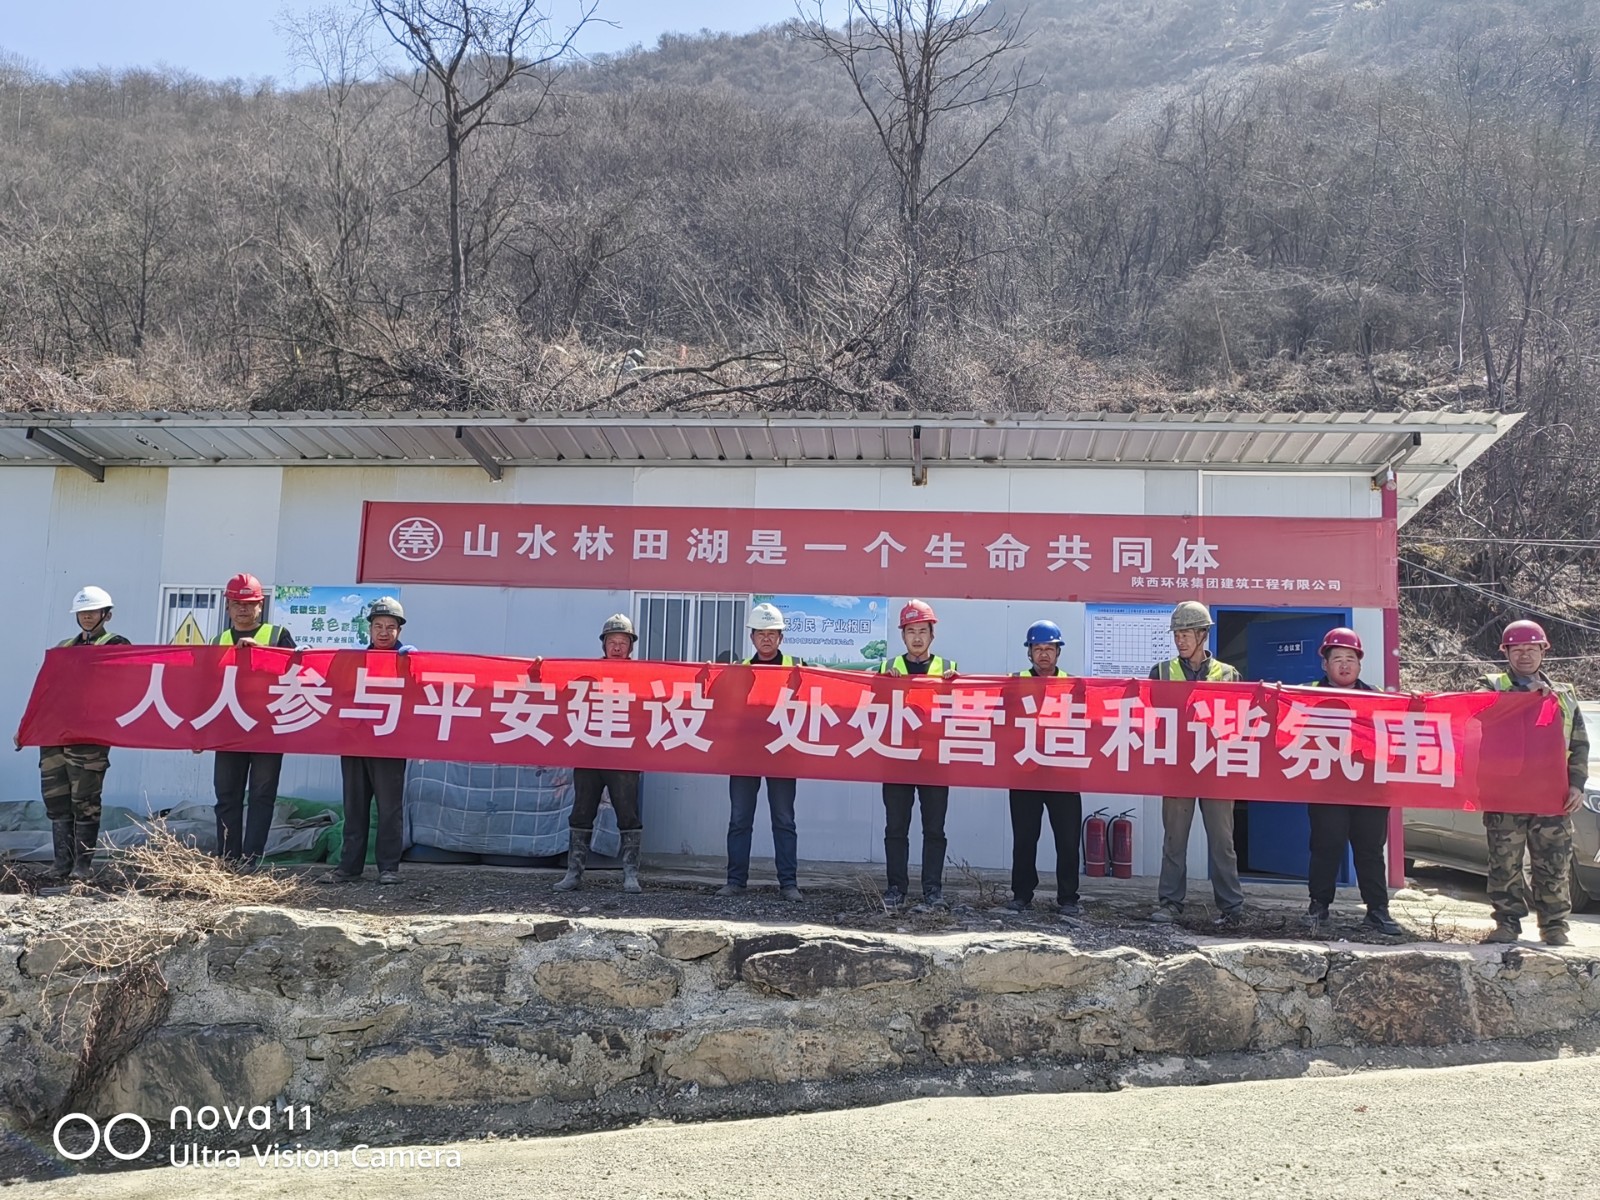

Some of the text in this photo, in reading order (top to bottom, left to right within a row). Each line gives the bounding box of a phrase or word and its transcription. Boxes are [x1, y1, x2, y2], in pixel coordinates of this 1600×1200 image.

[463, 523, 1220, 575] 山水林田湖是一个生命共同体
[1131, 576, 1342, 592] 陕西环保集团建筑工程有限公司
[821, 619, 871, 634] 产业报国
[115, 662, 1455, 788] 人人参与平安建设 处处营造和谐氛围
